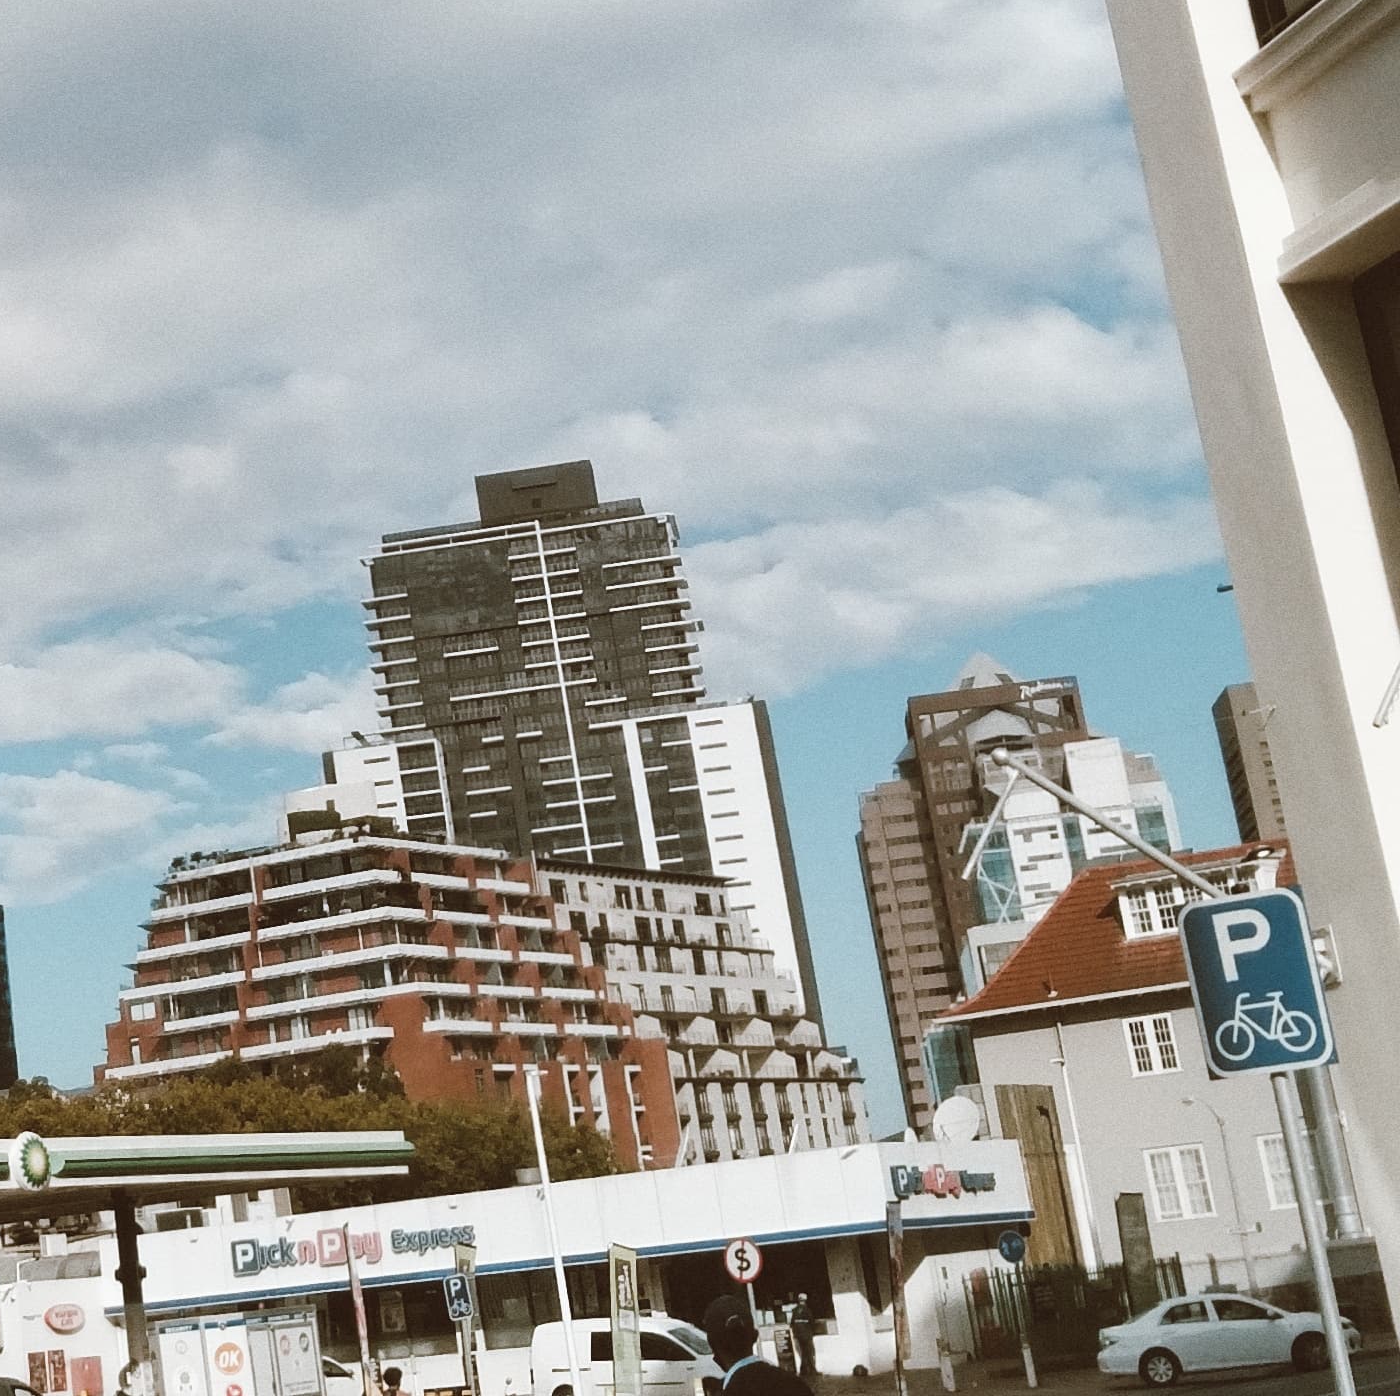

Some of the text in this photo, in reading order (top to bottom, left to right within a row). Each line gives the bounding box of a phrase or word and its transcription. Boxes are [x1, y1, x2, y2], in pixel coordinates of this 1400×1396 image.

[1211, 907, 1271, 984] P
[231, 1225, 476, 1277] Pick n Pay Express
[450, 1278, 462, 1298] P
[219, 1350, 240, 1368] OK
